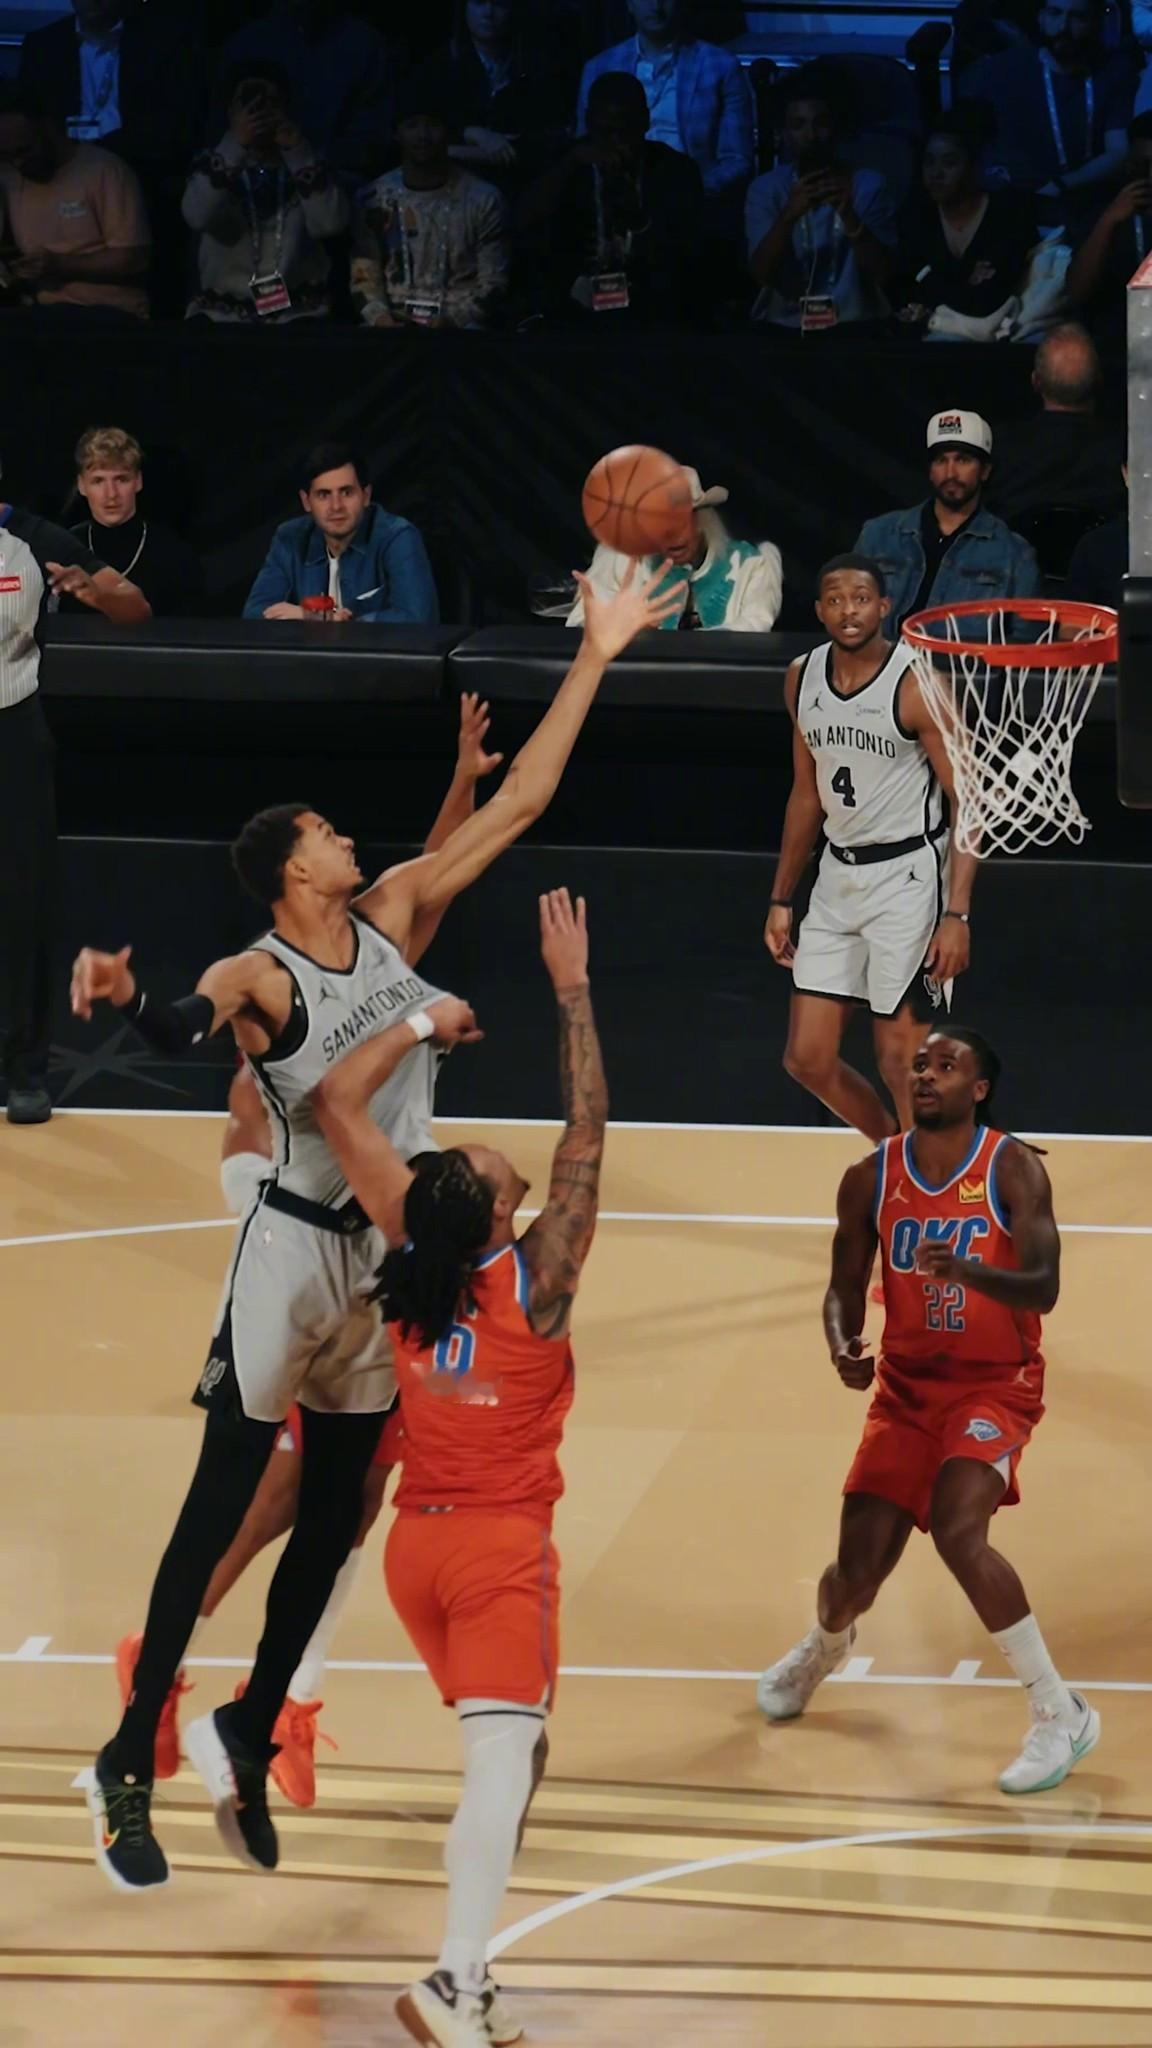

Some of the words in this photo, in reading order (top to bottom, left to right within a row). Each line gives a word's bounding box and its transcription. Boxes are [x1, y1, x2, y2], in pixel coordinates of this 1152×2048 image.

[938, 415, 962, 428] USA
[803, 727, 822, 749] AN
[826, 725, 896, 759] ANTONIO
[831, 766, 857, 808] 4
[890, 1215, 990, 1276] OKC
[923, 1282, 966, 1332] 22
